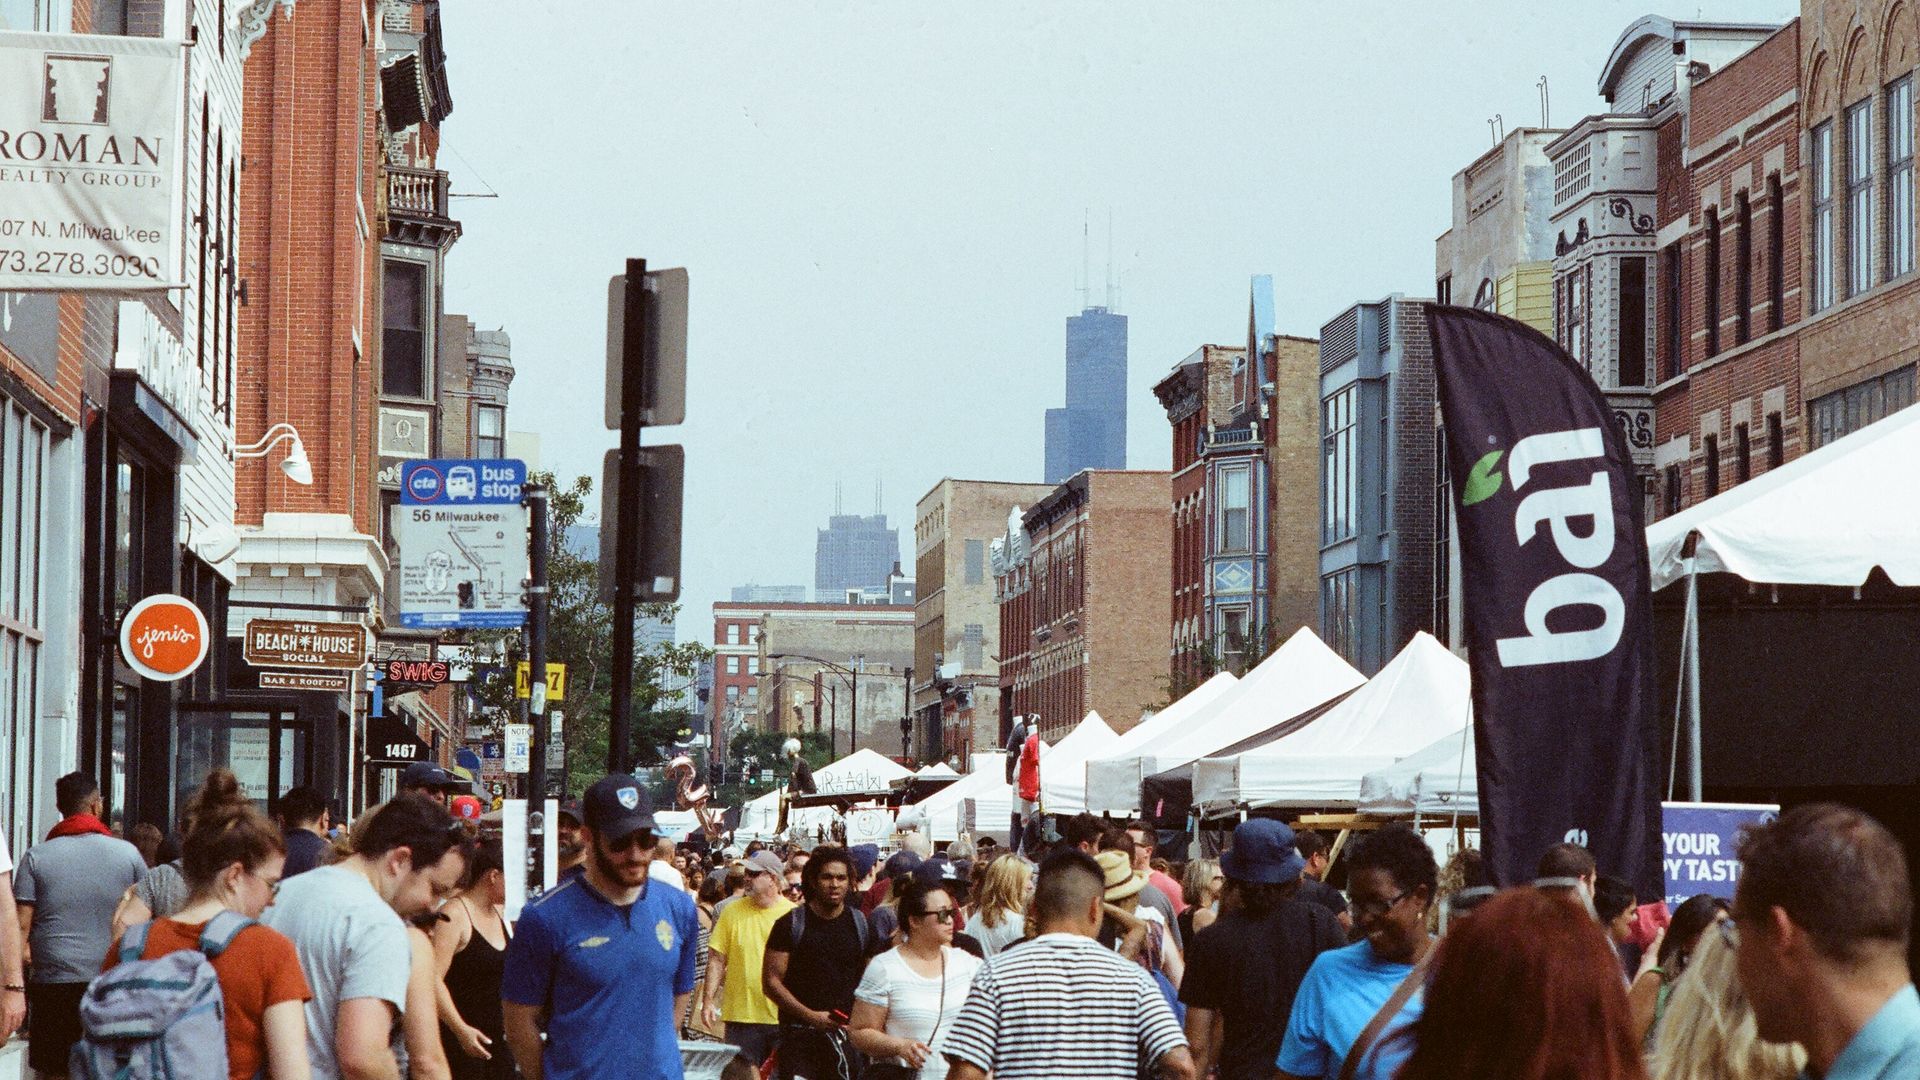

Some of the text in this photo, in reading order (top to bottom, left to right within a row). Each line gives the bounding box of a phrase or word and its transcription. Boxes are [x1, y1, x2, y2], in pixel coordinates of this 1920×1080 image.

[82, 171, 162, 188] GROUP
[31, 221, 52, 238] N.
[59, 222, 161, 243] Milwaukee
[413, 465, 515, 490] cta bus
[482, 483, 521, 500] stop
[412, 509, 499, 522] 56 Milwaukee
[293, 624, 318, 634] THE
[256, 633, 355, 654] BEACH HOUSE
[282, 653, 326, 663] SOCIAL
[389, 661, 448, 683] SWIG
[263, 676, 286, 684] BAR
[299, 678, 344, 687] ROOFTOP
[385, 744, 417, 758] 1467
[1662, 832, 1720, 856] YOUR
[1684, 858, 1744, 881] TAST
